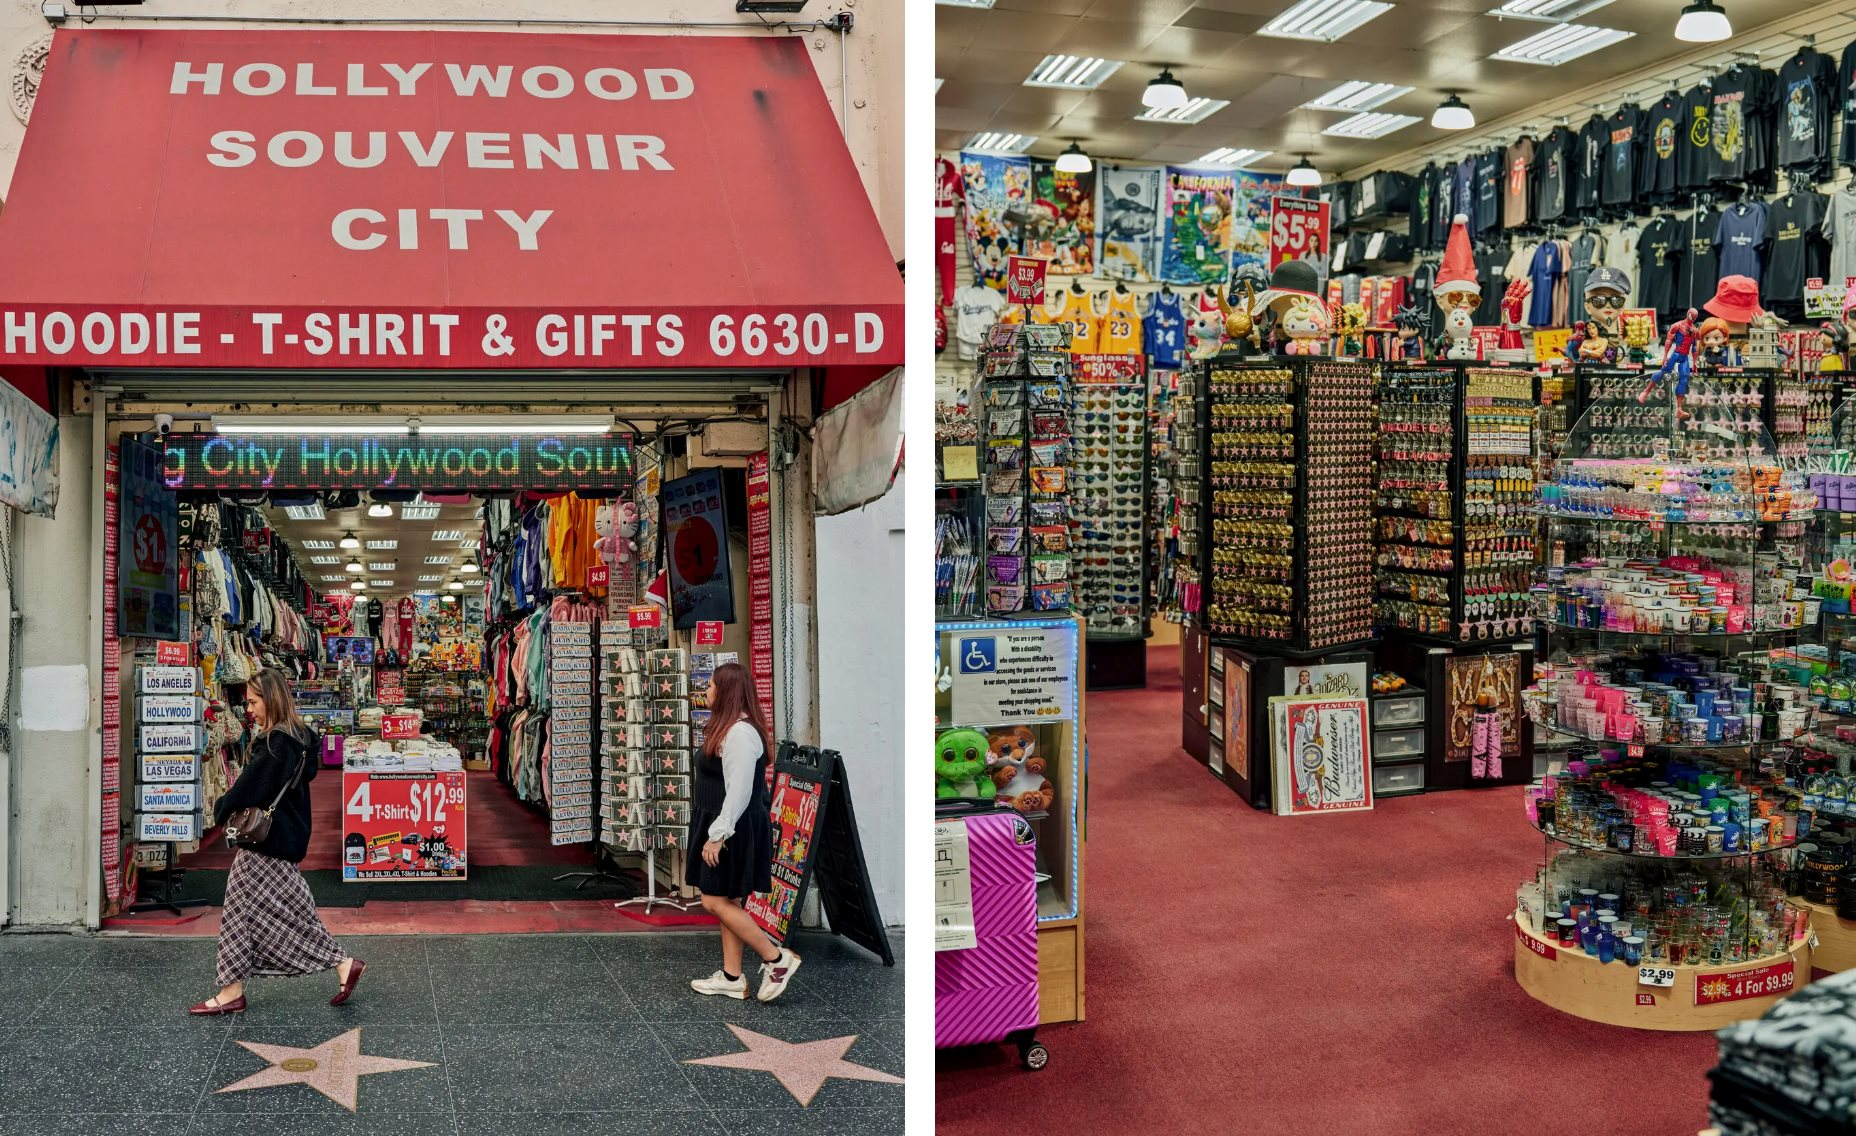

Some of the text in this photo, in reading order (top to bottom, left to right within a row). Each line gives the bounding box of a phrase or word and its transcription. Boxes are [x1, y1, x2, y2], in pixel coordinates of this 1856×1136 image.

[170, 62, 694, 100] HOLLYWOOD
[206, 131, 675, 171] SOUVENIR
[1170, 174, 1232, 191] CALIFORNIA
[1279, 200, 1319, 211] Everything Sale
[331, 208, 553, 251] CITY
[1018, 268, 1035, 281] $3.99
[962, 304, 991, 314] Dodgers
[5, 312, 201, 355] HOODIE
[252, 313, 459, 356] T-SHRIT
[482, 314, 515, 357] &
[535, 314, 684, 357] GIFTS
[709, 312, 884, 357] 6630-D
[1111, 321, 1131, 337] 23
[1156, 330, 1176, 347] 34
[1091, 362, 1118, 377] 50%
[202, 438, 285, 485] City
[301, 438, 519, 485] Hollywood
[147, 678, 192, 688] LOS ANGELES
[146, 707, 192, 718] HOLLYWOOD
[1318, 701, 1361, 710] GENUINE
[384, 720, 392, 733] 3
[146, 736, 192, 747] CALIFORNIA
[1324, 712, 1341, 802] Budweiser
[146, 766, 192, 776] LAS VEGAS
[144, 795, 190, 805] SANTA MONICA
[346, 782, 374, 822] 4
[375, 804, 410, 820] T-Shirt
[771, 788, 785, 821] 4
[1323, 801, 1366, 810] GENUINE
[144, 825, 188, 835] BEVERLY HILLS
[420, 842, 445, 852] $1.00
[784, 868, 801, 887] Drinks
[1531, 939, 1545, 954] 9.99
[1640, 969, 1674, 979] $2.99
[1727, 970, 1754, 979] Special
[1703, 984, 1727, 996] $2.99
[1735, 982, 1742, 996] 4
[1746, 980, 1764, 994] For
[1766, 971, 1794, 991] $9.99
